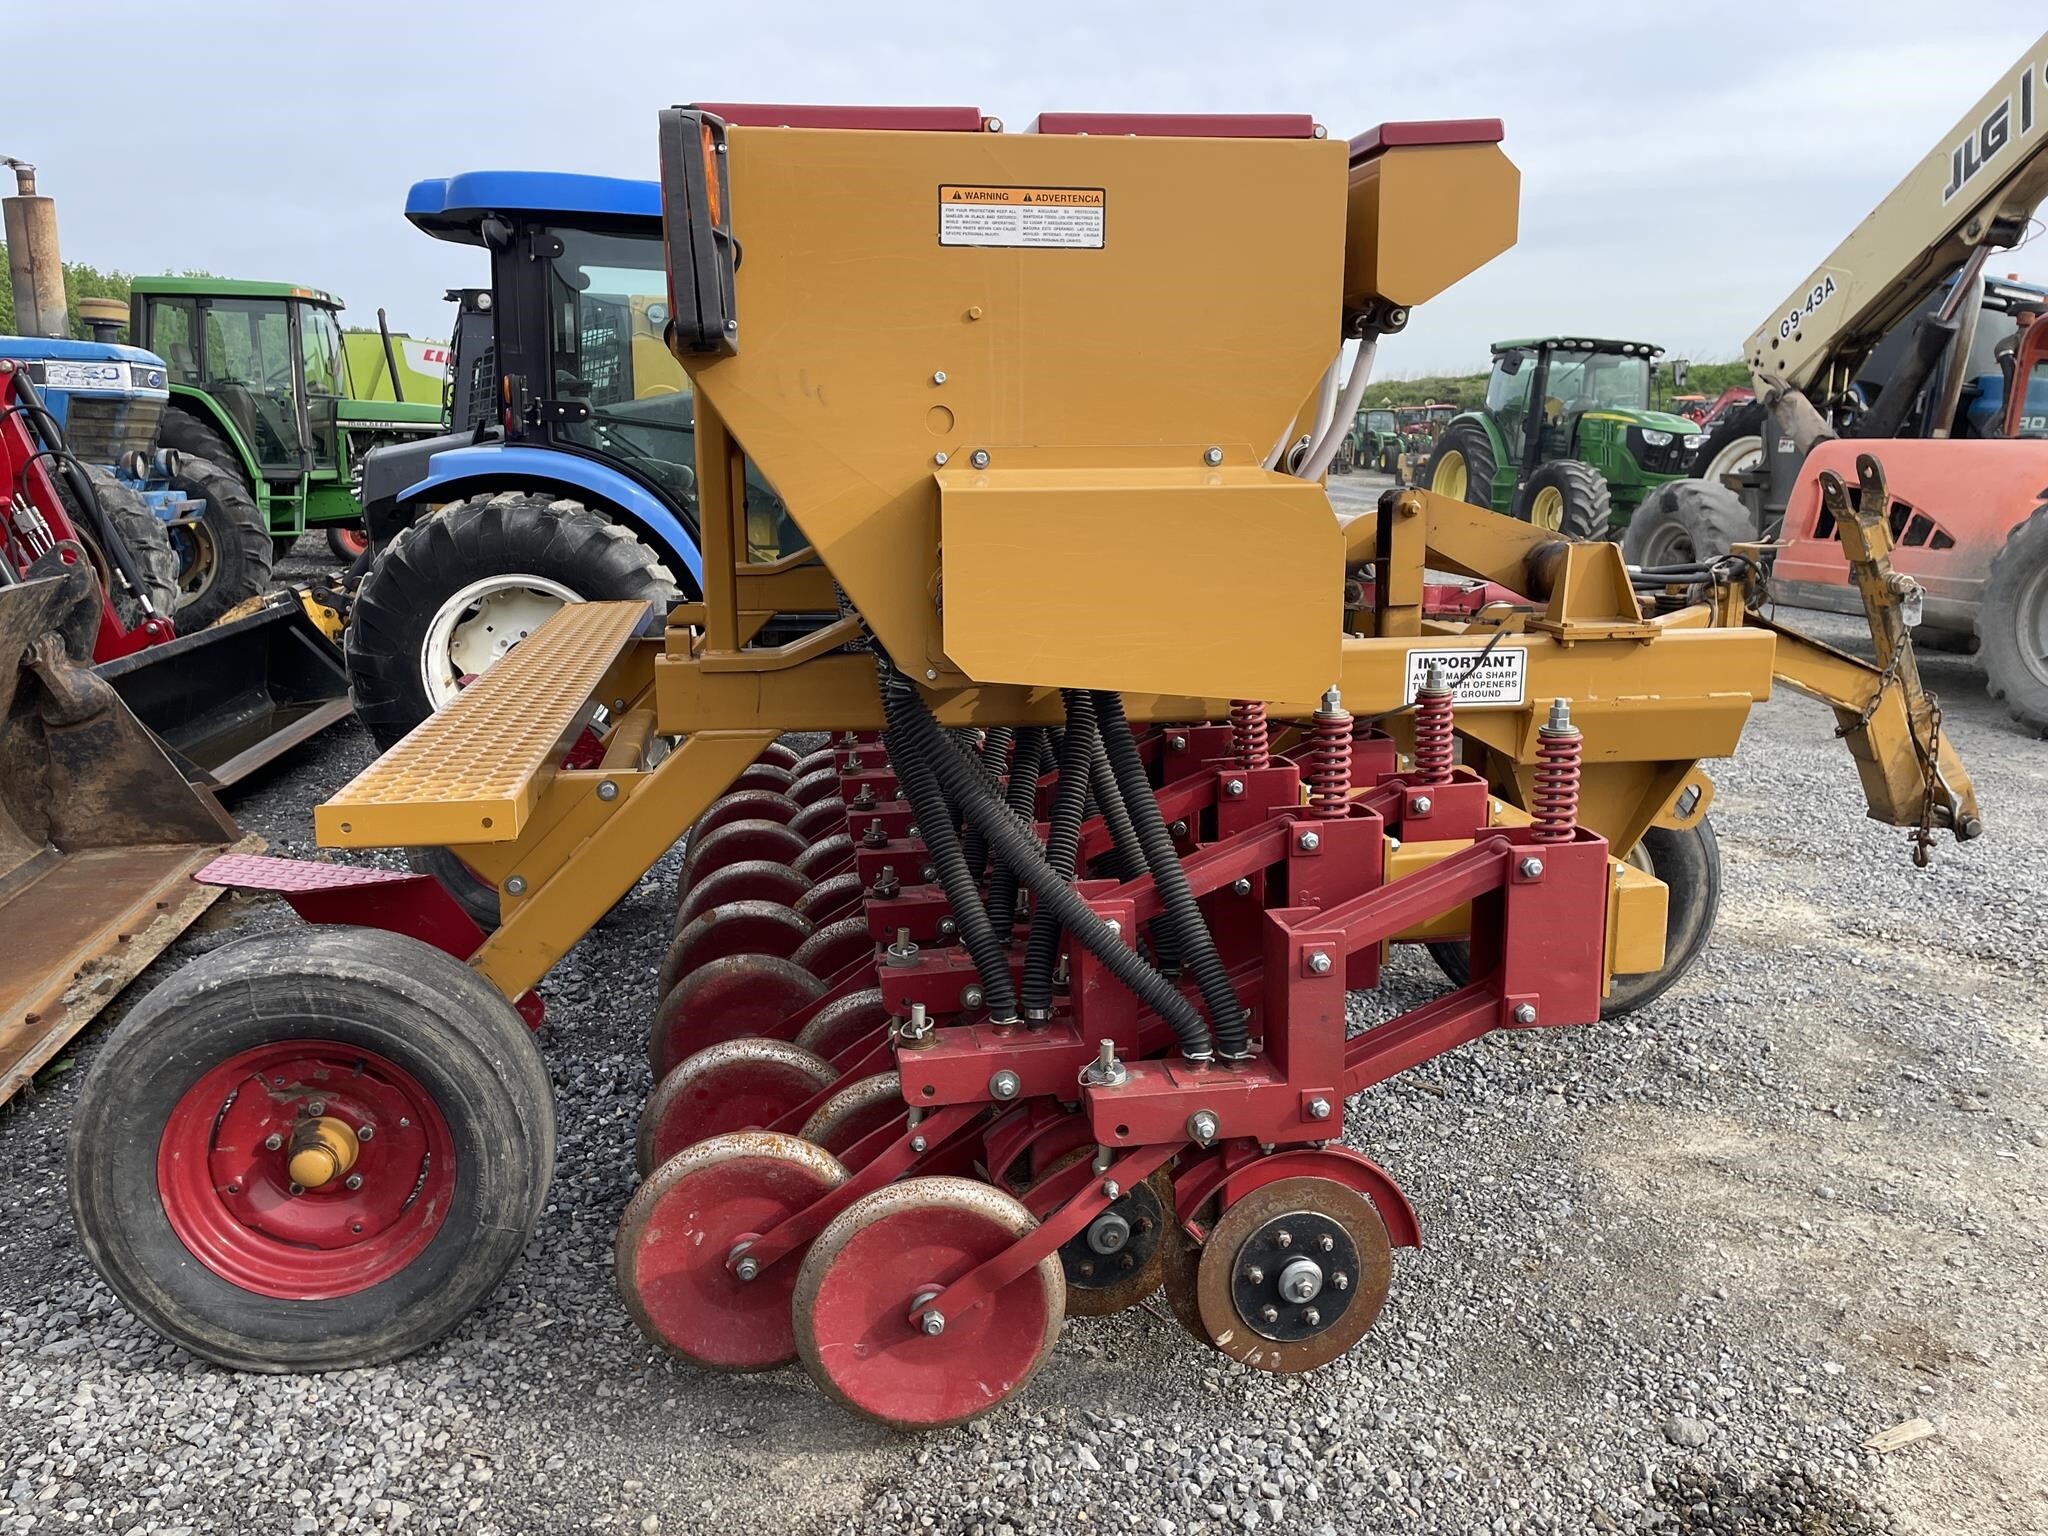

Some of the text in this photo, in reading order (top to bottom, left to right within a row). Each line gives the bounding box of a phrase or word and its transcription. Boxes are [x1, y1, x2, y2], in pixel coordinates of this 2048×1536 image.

[1942, 95, 2010, 204] JLG
[964, 191, 1009, 201] WARNING
[1035, 193, 1101, 204] ADVERTENCIA
[1780, 276, 1835, 338] G9-43A
[1417, 656, 1516, 669] IMPORTANT
[1445, 671, 1518, 680] MAKING SHARP
[1446, 680, 1518, 689] WITH OPENERS
[1460, 689, 1501, 698] GROUND
